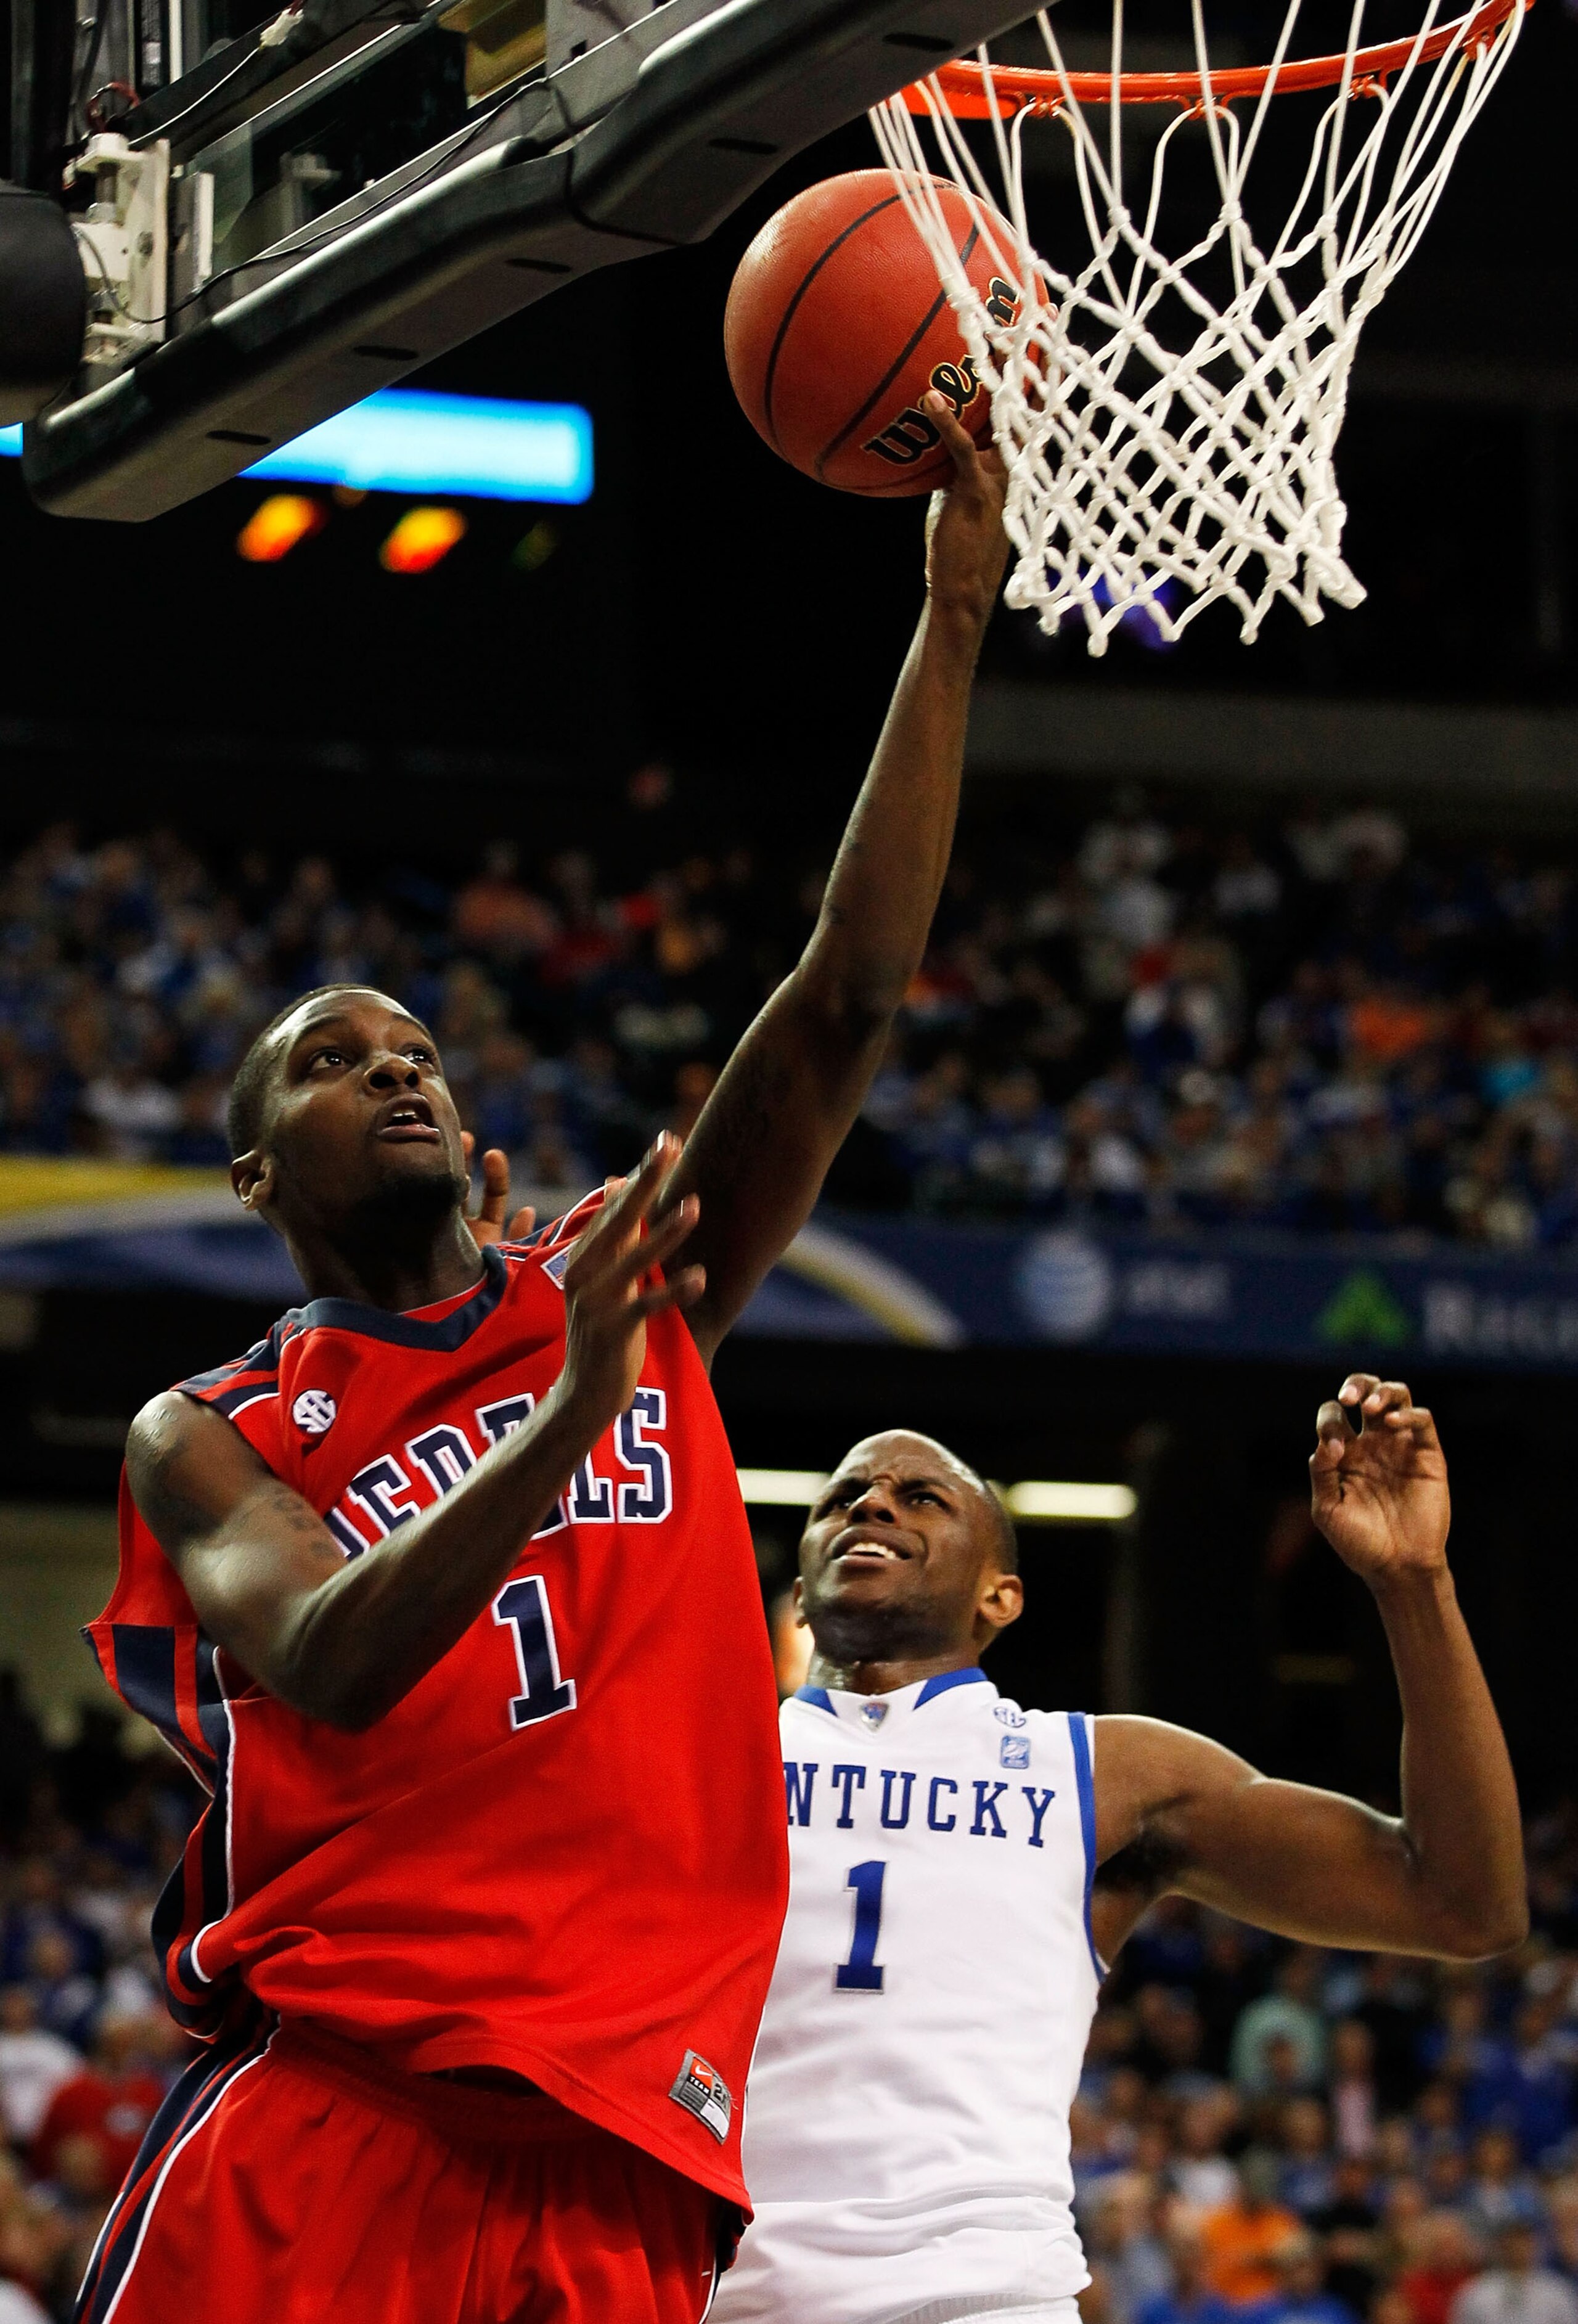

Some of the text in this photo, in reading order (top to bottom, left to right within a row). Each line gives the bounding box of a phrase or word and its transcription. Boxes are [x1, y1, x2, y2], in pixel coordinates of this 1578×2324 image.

[491, 1574, 577, 1731] 1
[833, 1860, 888, 1995] 1
[690, 2076, 709, 2094] TEAM
